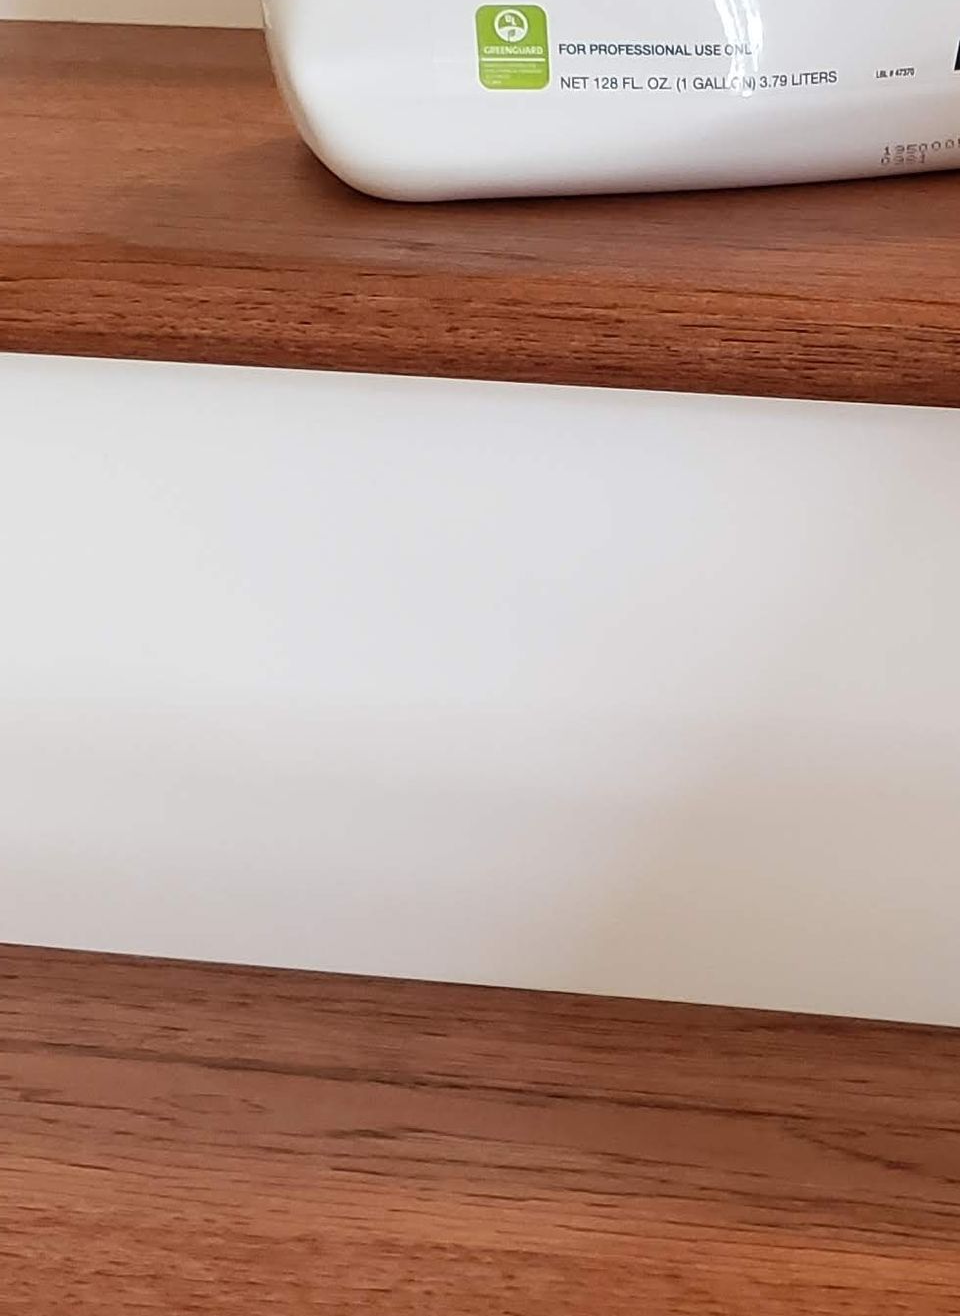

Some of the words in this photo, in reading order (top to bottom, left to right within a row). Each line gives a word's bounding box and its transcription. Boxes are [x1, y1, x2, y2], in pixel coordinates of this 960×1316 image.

[558, 44, 587, 56] FOR
[589, 44, 692, 57] PROFESSIONAL
[694, 44, 722, 56] USE
[724, 44, 759, 56] ONL
[560, 76, 590, 90] NET
[593, 76, 619, 90] 128
[759, 74, 788, 88] 3.79
[791, 70, 838, 87] LITERS
